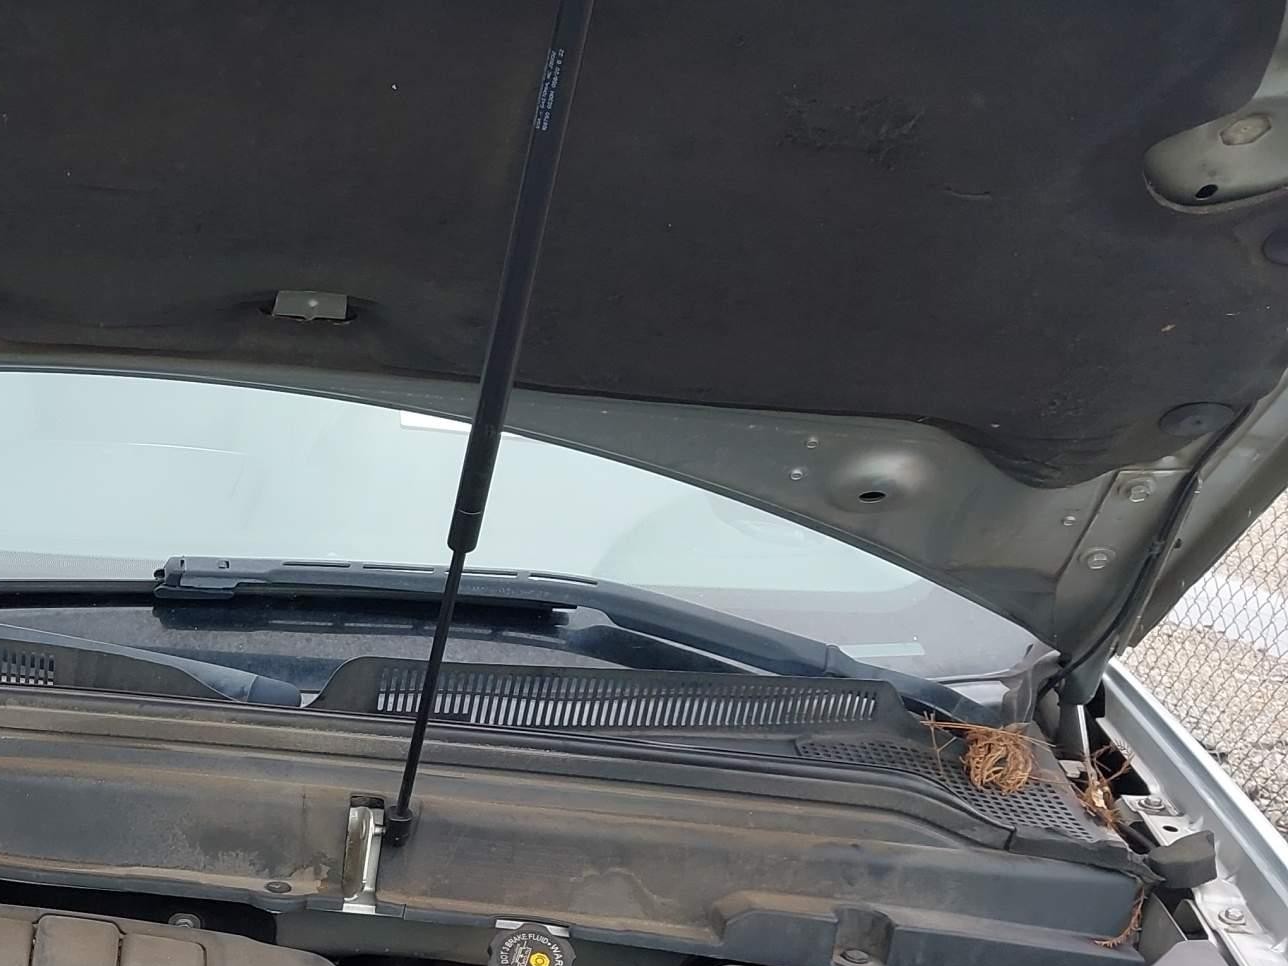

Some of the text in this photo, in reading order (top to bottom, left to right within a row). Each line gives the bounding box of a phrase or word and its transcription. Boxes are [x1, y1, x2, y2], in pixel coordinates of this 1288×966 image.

[499, 951, 509, 964] DOT
[505, 933, 529, 948] BRAKE
[528, 933, 549, 944] FLUID
